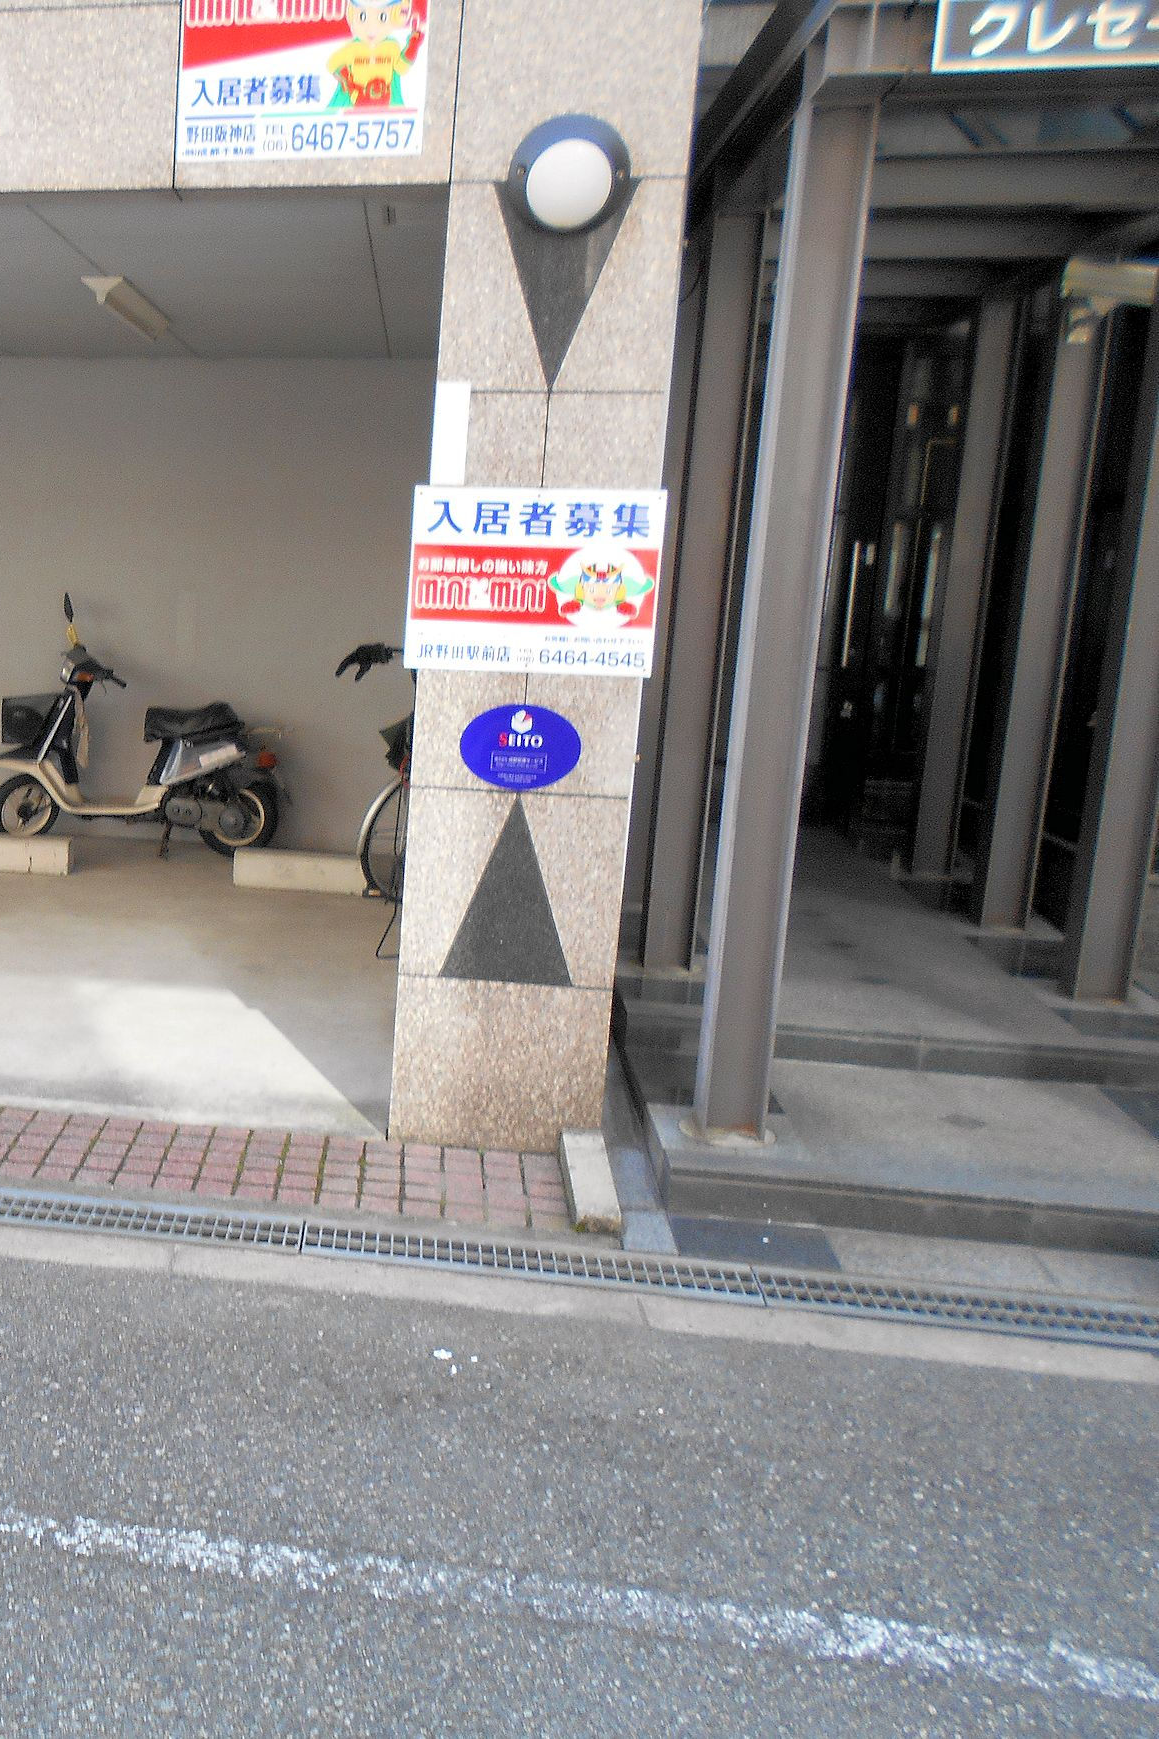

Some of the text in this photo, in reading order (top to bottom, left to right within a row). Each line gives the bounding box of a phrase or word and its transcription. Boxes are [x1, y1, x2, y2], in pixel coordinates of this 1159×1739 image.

[969, 0, 1159, 58] クレセ
[191, 74, 321, 107] 入居者募集
[187, 124, 256, 144] 野田阪神店
[292, 119, 415, 152] 6467-5757
[428, 500, 649, 538] 入居者募集
[539, 648, 645, 668] 6464-4545
[498, 732, 543, 749] SEITO
